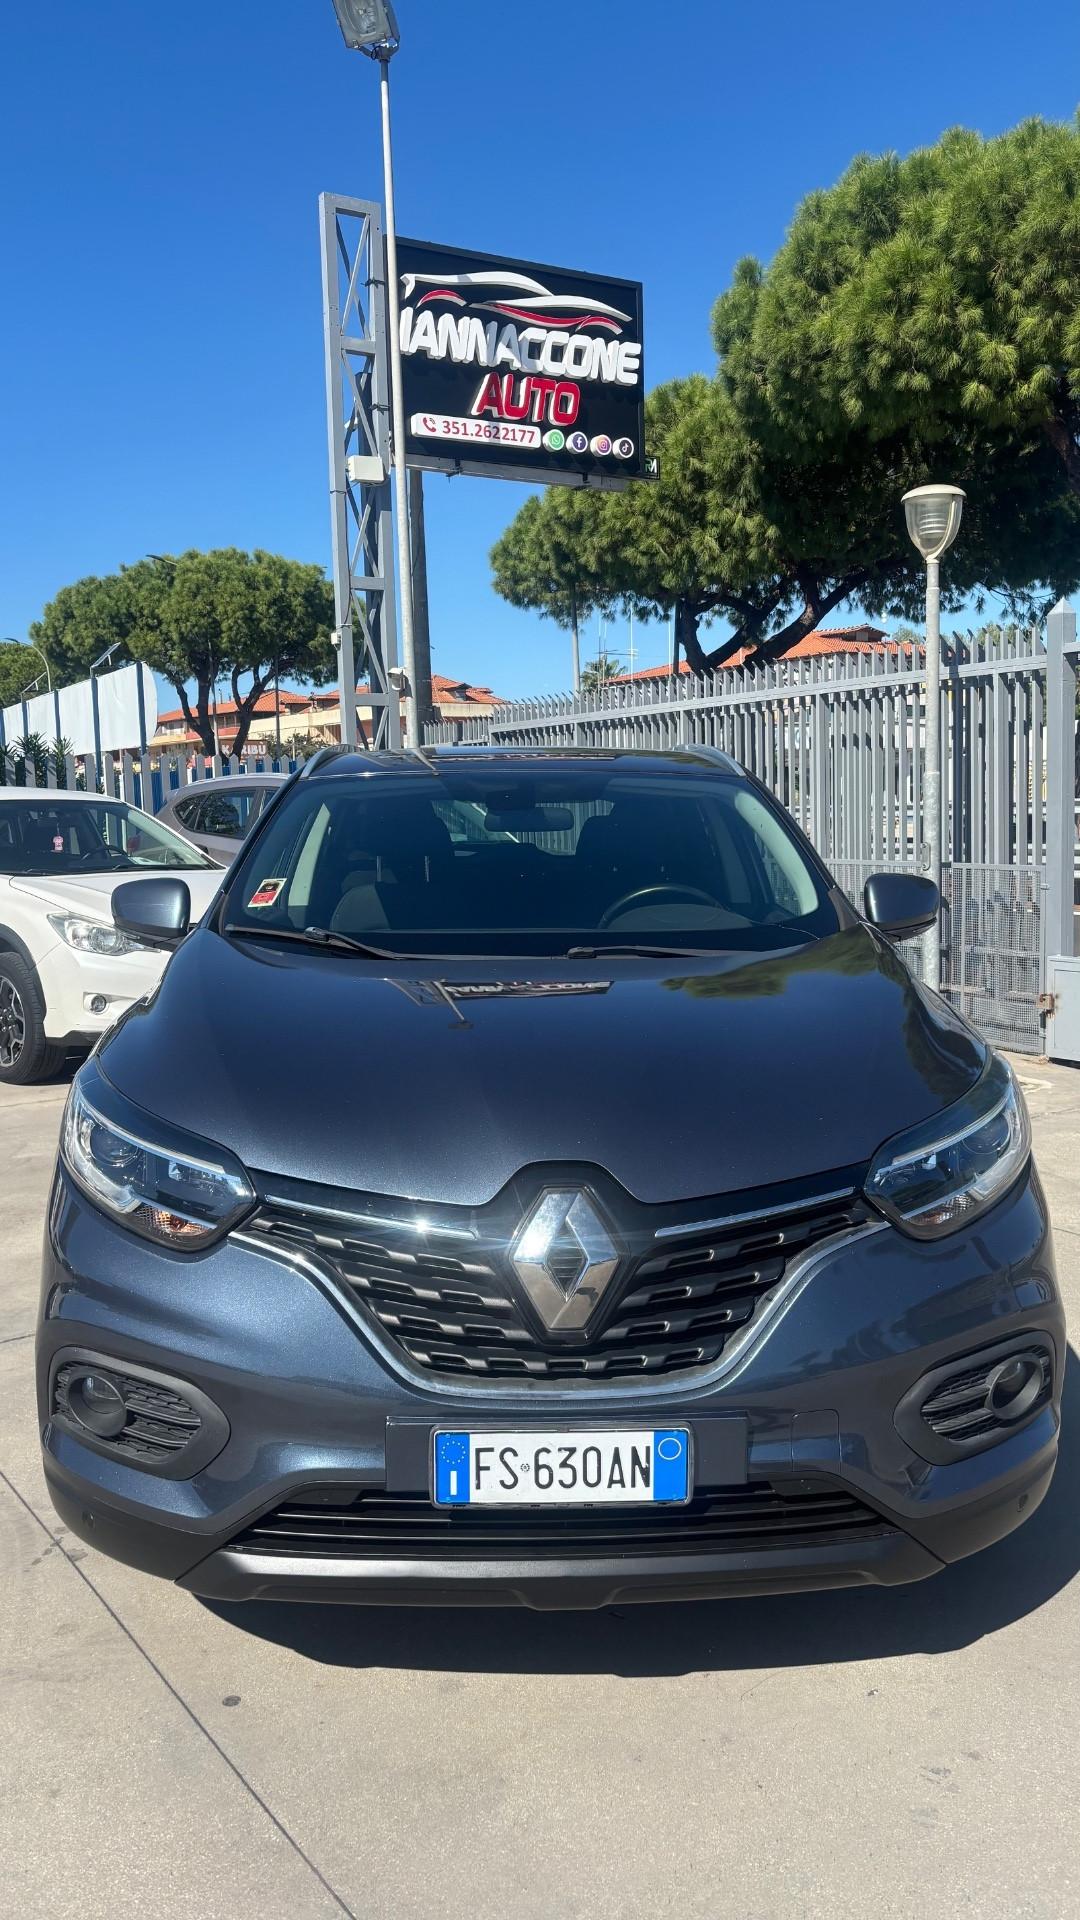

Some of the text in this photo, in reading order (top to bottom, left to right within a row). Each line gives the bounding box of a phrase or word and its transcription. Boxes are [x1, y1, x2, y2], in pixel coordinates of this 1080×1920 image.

[399, 307, 642, 386] IANNACCONE
[471, 372, 580, 426] AUTO
[442, 421, 535, 444] 351.2622177
[221, 742, 266, 755] KRIBÙ
